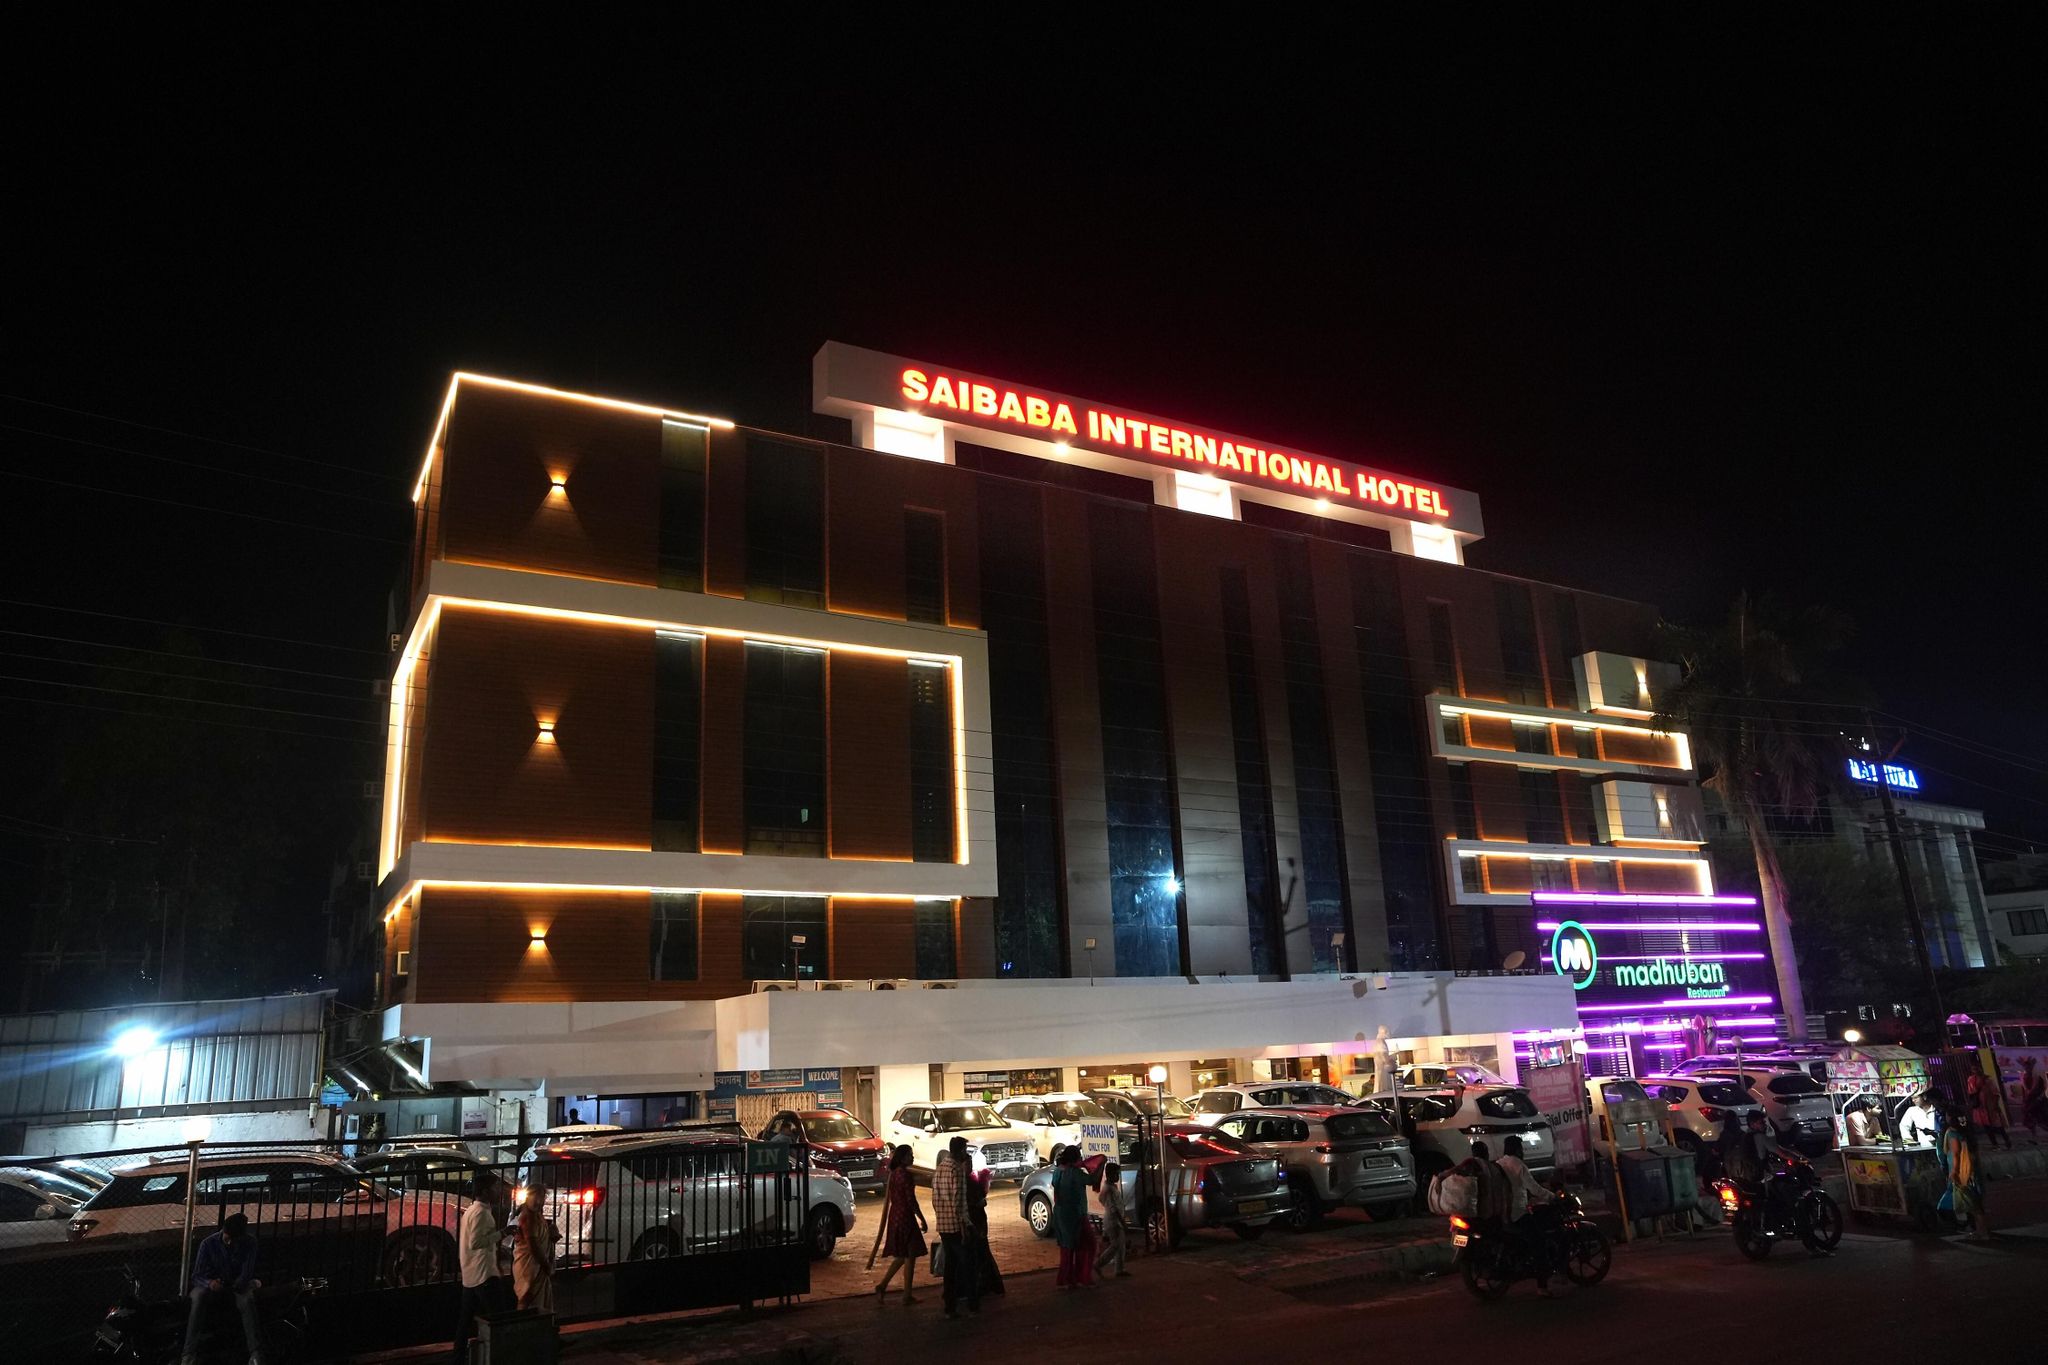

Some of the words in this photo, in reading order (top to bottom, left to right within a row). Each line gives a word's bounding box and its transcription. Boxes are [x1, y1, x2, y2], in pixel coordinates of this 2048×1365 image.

[901, 369, 1078, 434] SAIBABA
[1088, 410, 1351, 495] INTERNATIONAL
[1357, 472, 1449, 517] HOTEL
[1560, 938, 1592, 970] M
[1615, 958, 1724, 987] madhuban
[1687, 986, 1727, 998] Restaurant
[808, 1071, 839, 1082] WELCOME
[1563, 1108, 1583, 1123] Offer
[1082, 1124, 1115, 1139] PARKING
[1088, 1143, 1100, 1152] ONLY
[1101, 1143, 1110, 1152] FOR
[755, 1148, 780, 1166] IN
